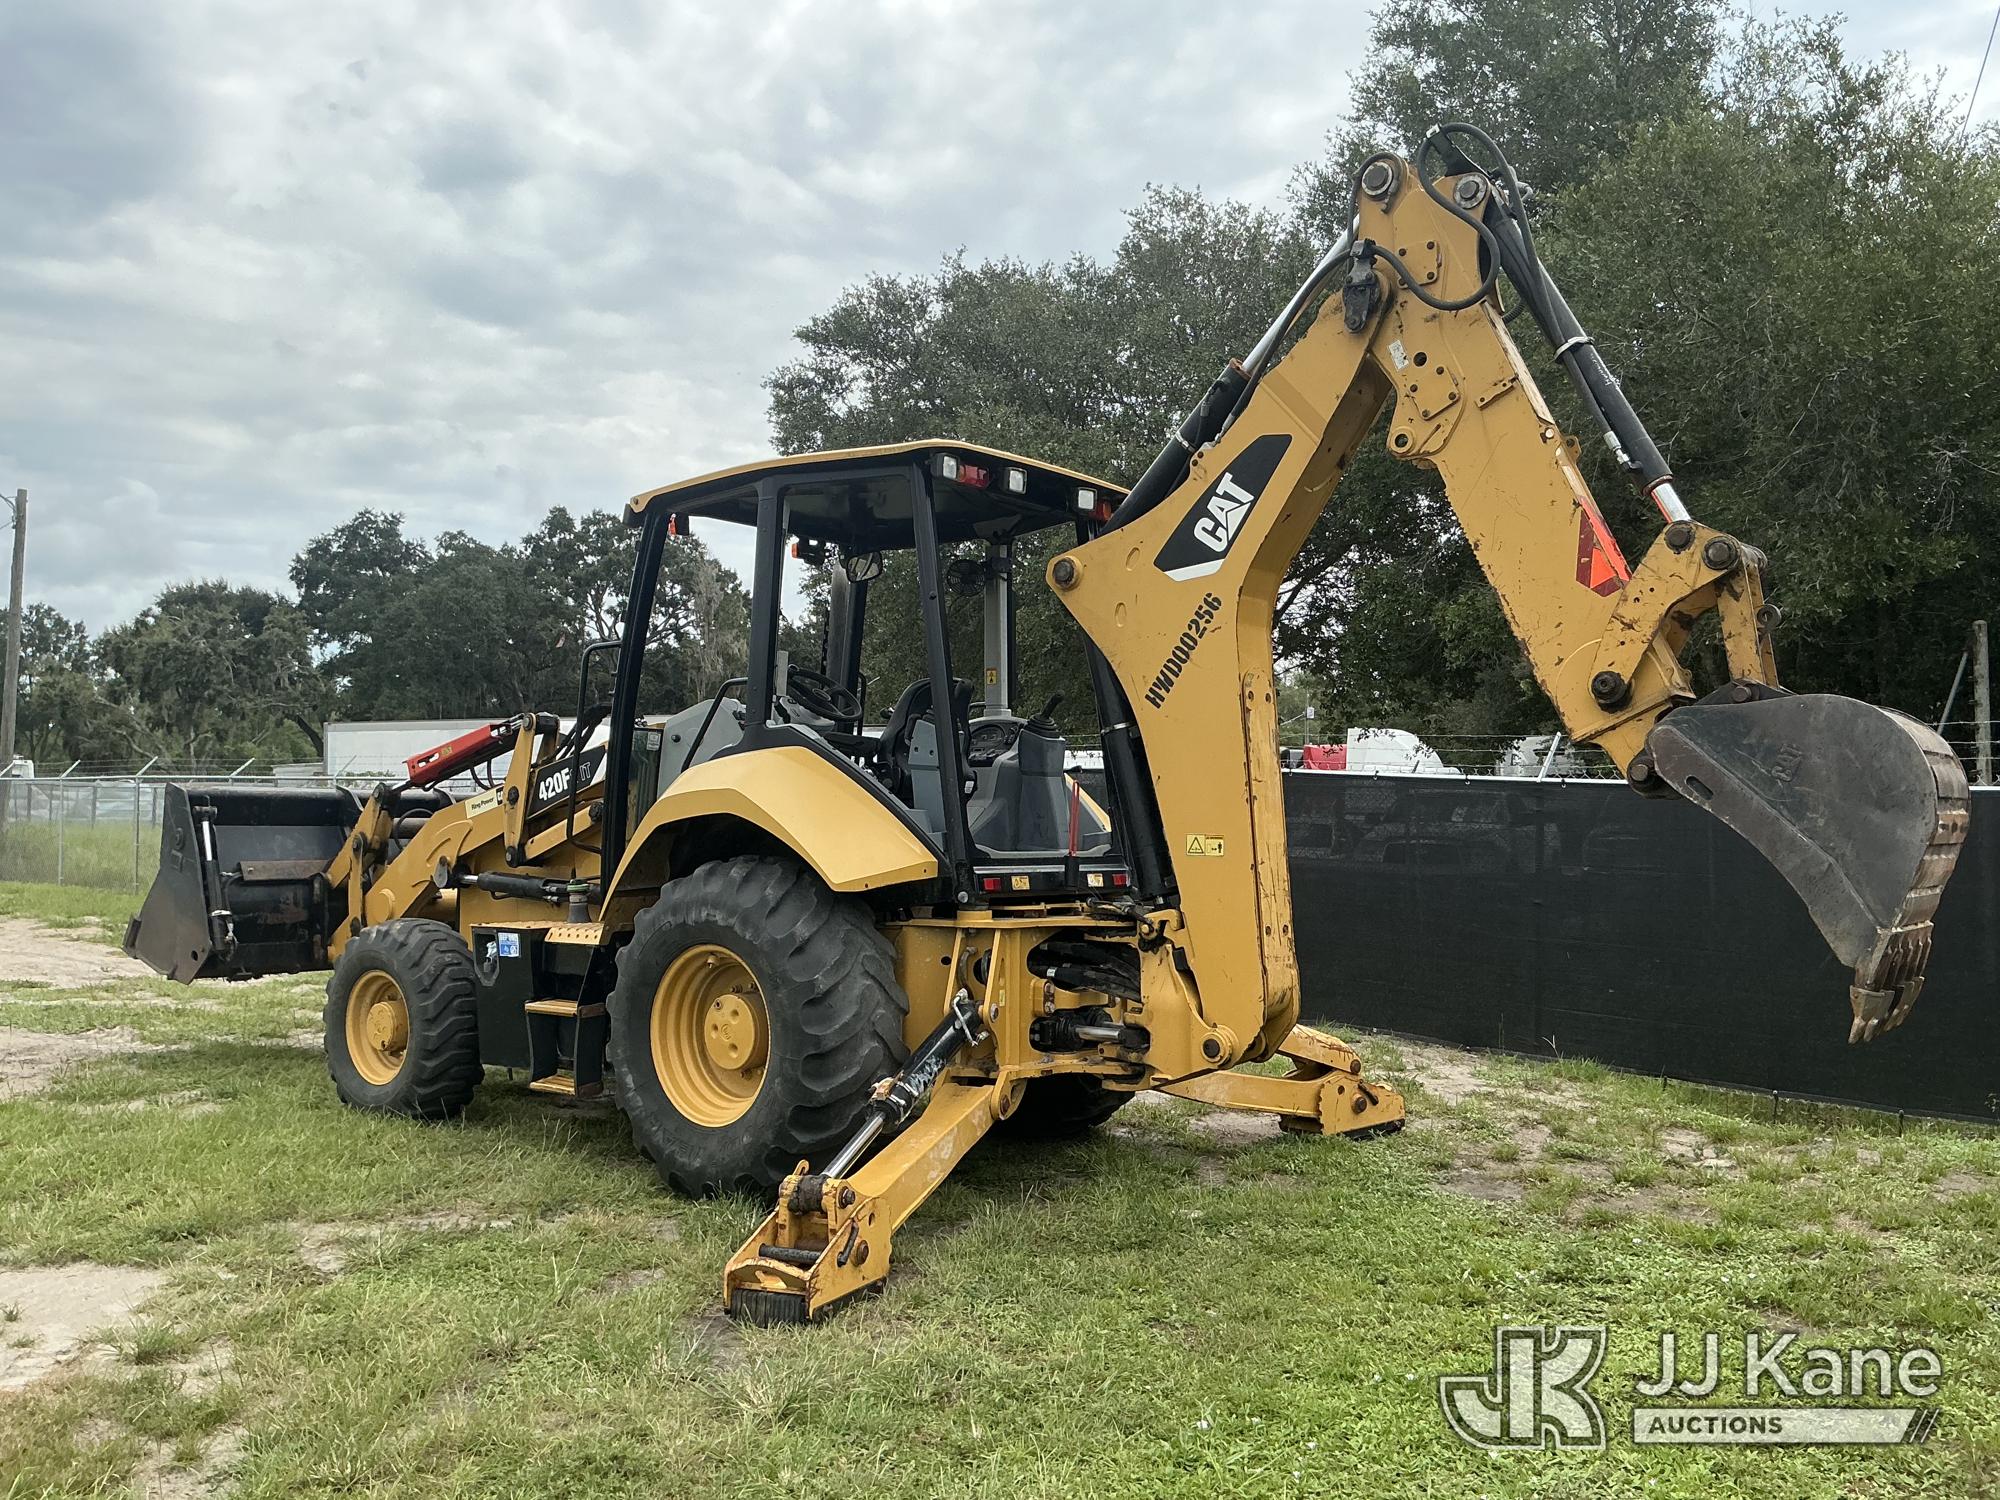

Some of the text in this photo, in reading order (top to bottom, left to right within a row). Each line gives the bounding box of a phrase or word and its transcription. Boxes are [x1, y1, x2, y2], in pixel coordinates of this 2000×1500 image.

[1193, 472, 1255, 552] CAT
[1144, 592, 1222, 708] HWD00256
[538, 767, 570, 801] 420F
